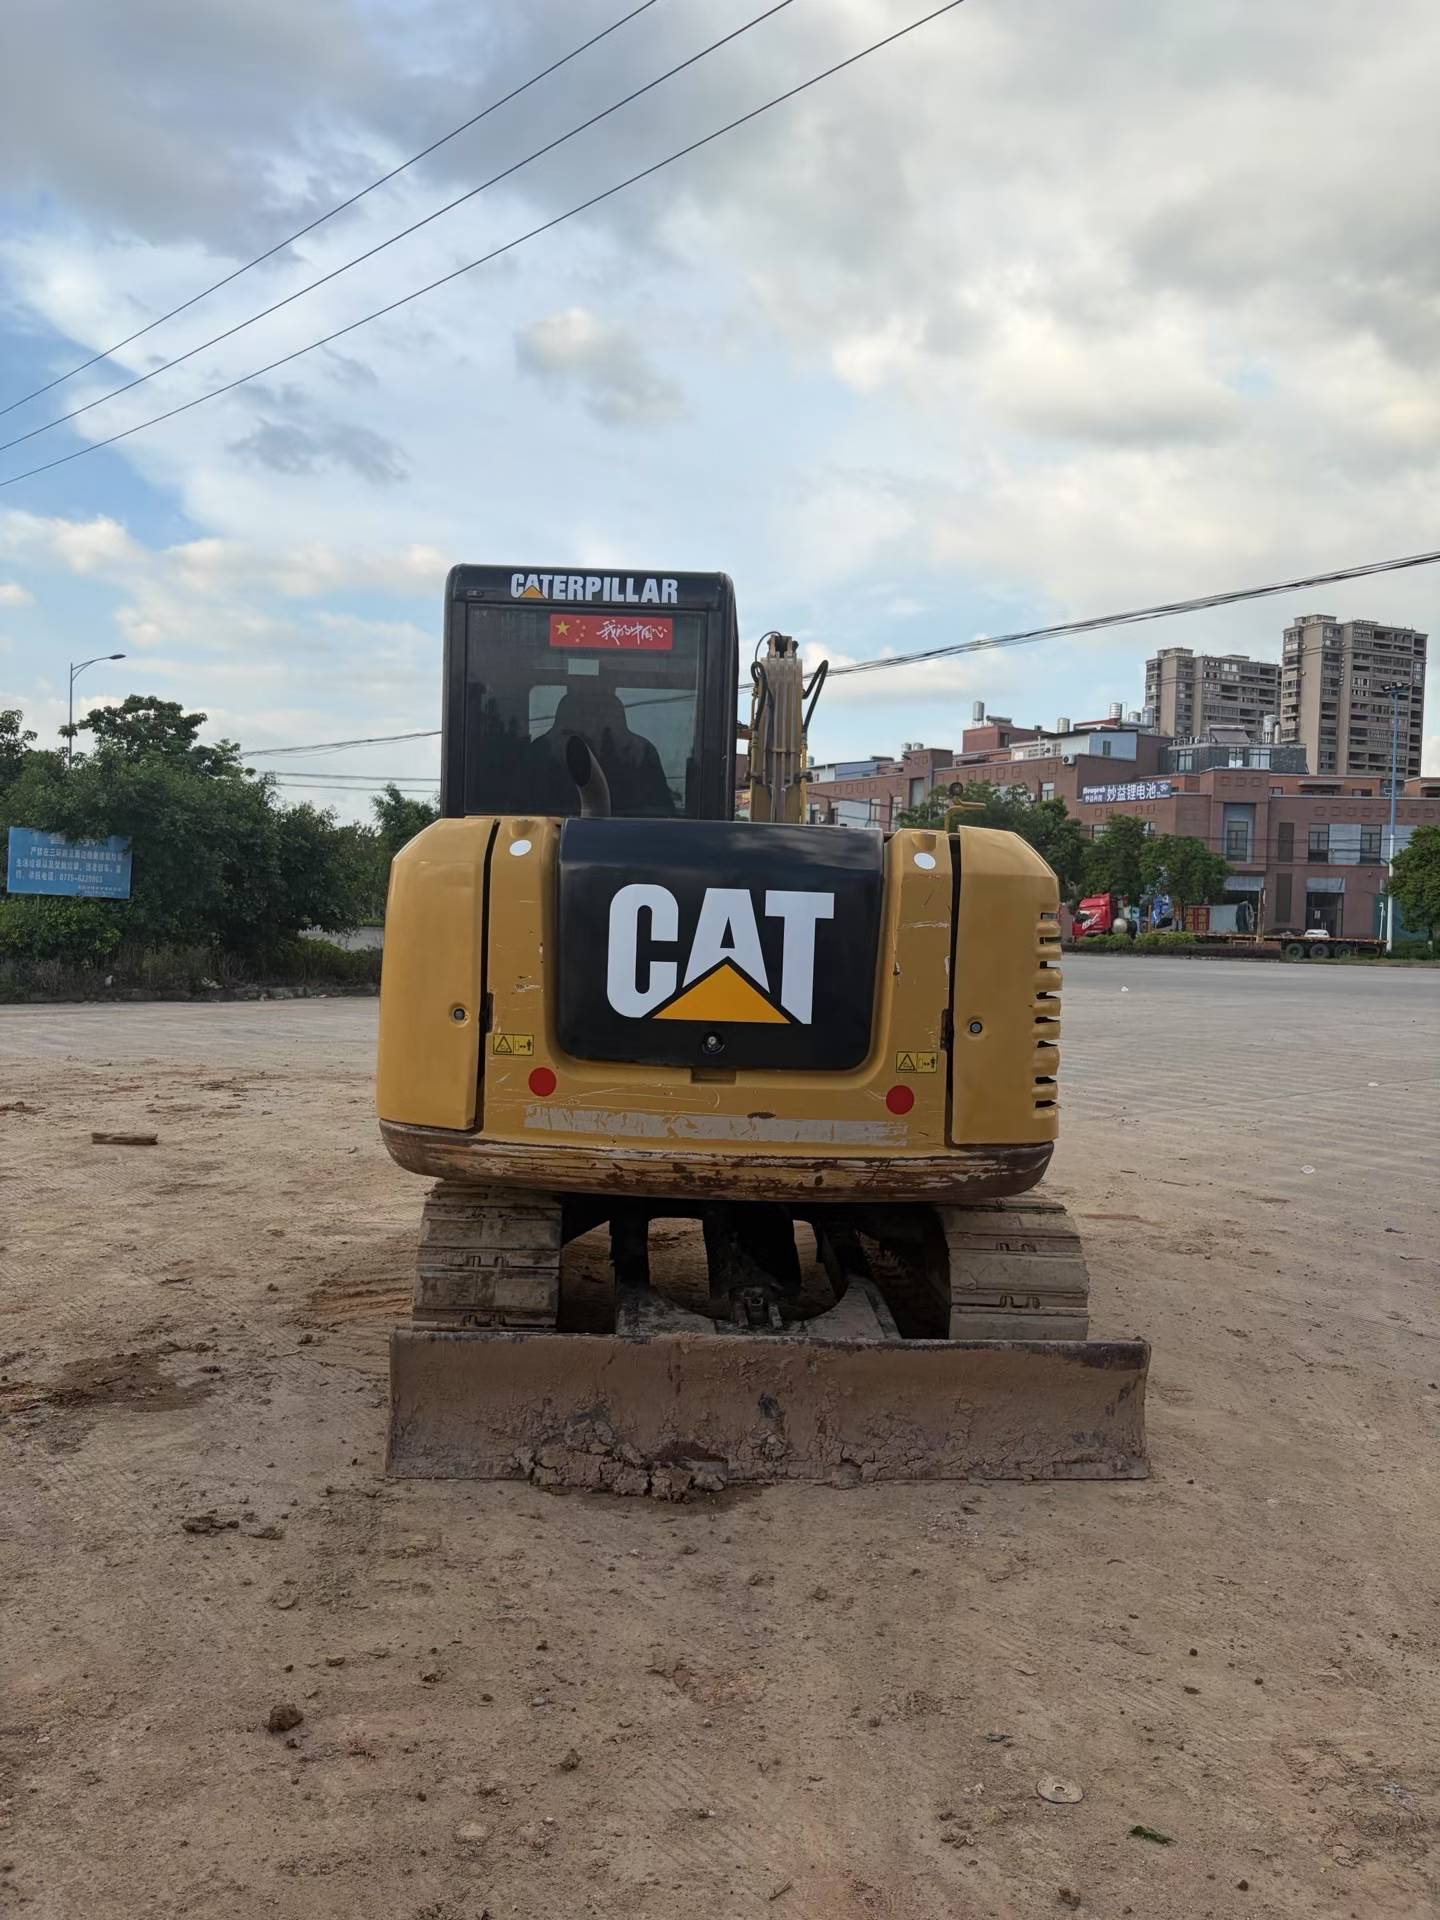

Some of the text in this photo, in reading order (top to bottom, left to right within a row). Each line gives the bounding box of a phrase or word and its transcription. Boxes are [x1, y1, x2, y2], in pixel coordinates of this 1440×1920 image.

[510, 573, 679, 604] CATERPILLAR
[595, 618, 669, 646] 我的中国心
[606, 883, 835, 1025] CAT
